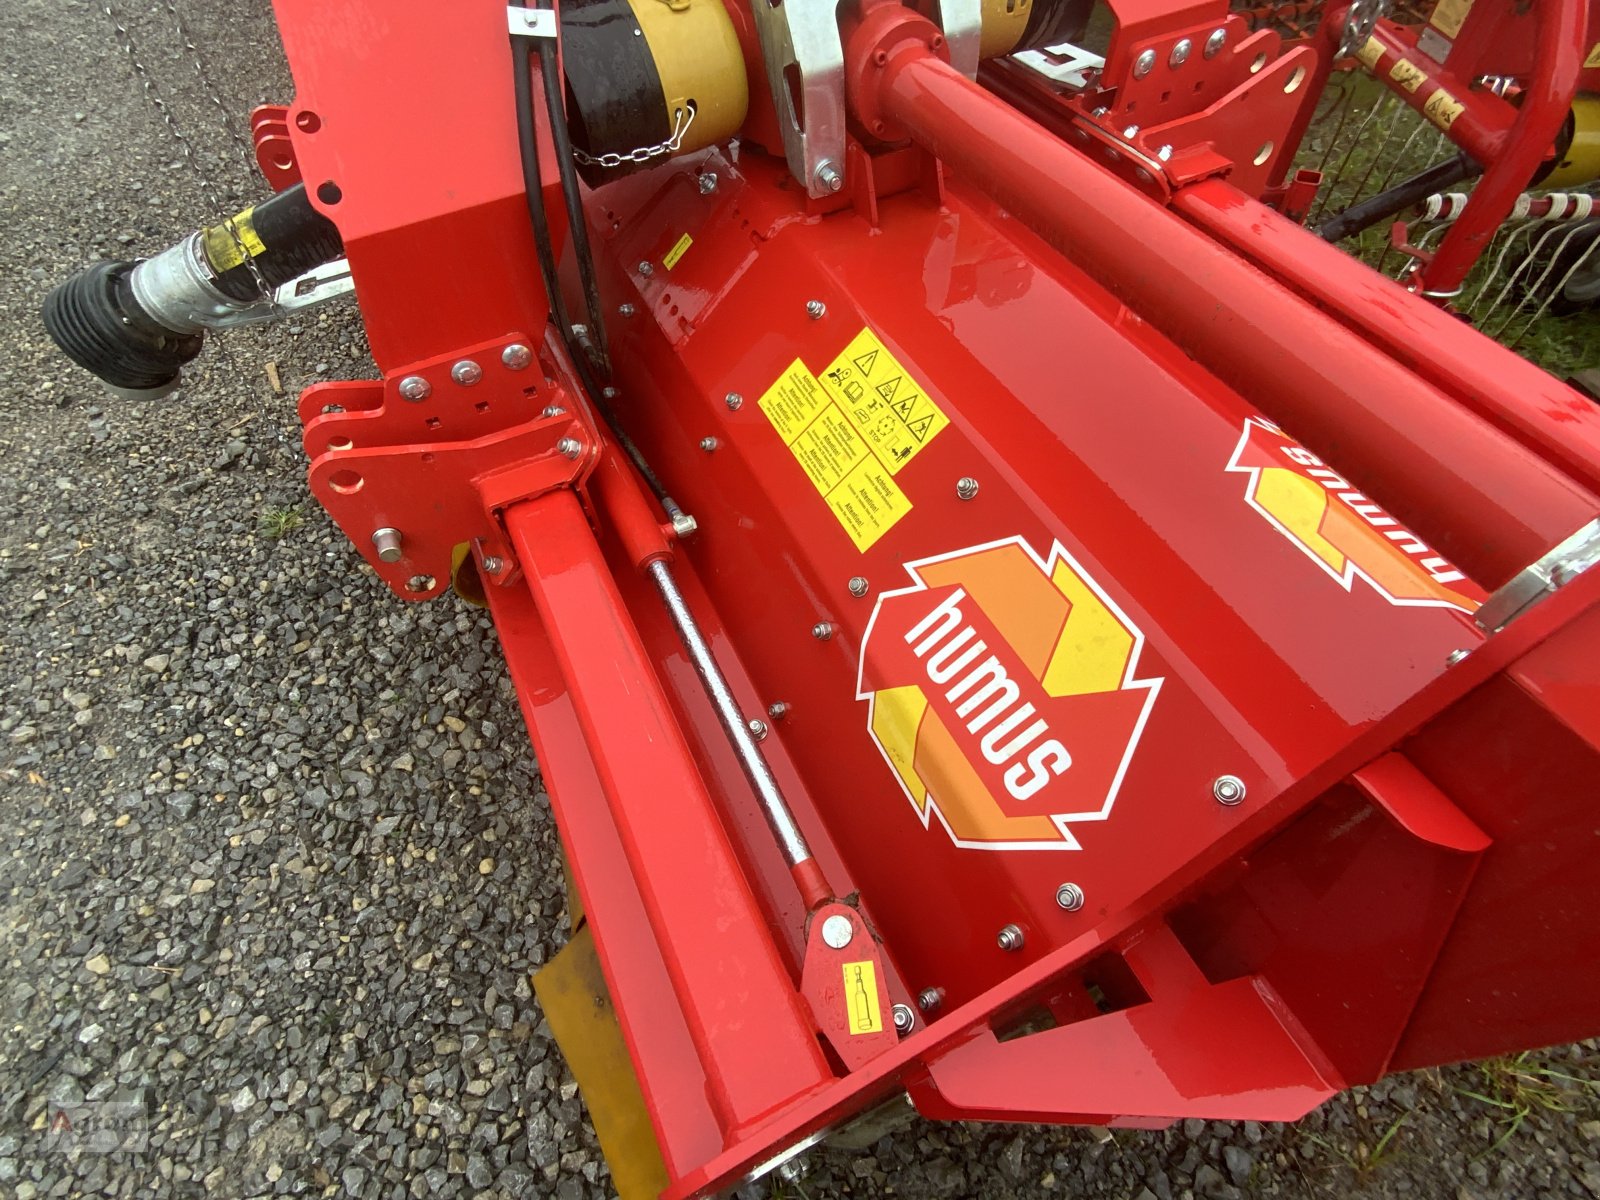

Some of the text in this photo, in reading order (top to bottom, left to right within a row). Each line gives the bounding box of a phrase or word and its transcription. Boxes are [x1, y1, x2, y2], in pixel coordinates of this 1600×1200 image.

[837, 420, 854, 441] Achtung!
[868, 429, 881, 443] STOP
[823, 434, 840, 456] Attention!
[809, 448, 827, 470] Attention!
[874, 474, 893, 497] Achtung!
[859, 487, 879, 513] Attention!
[844, 502, 864, 526] Attention!
[1280, 446, 1466, 583] humus
[904, 588, 1072, 800] humus
